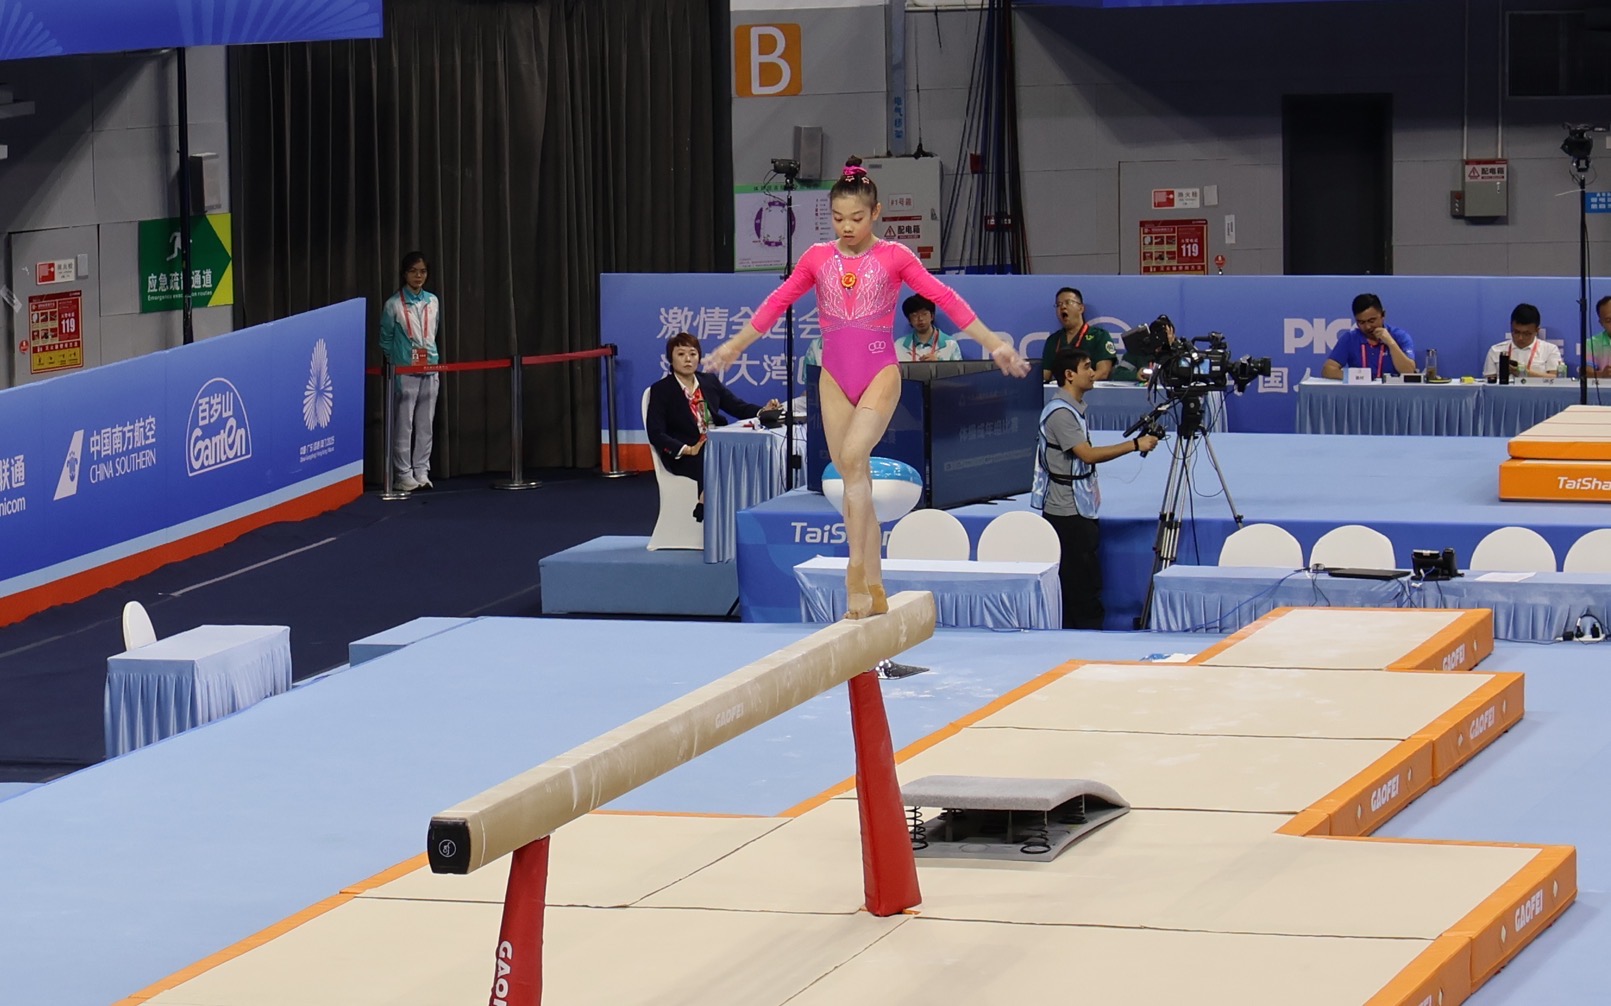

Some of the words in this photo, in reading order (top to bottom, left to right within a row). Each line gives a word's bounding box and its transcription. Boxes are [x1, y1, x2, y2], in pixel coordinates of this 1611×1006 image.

[749, 25, 793, 96] B
[1480, 166, 1505, 175] 配电箱
[897, 224, 921, 235] 配电箱
[1180, 243, 1200, 257] 119
[147, 268, 214, 293] 应急疏通道
[60, 317, 77, 335] 119
[1283, 318, 1358, 354] PIC
[198, 391, 234, 427] 百岁山
[89, 414, 157, 461] 中国南方航空
[89, 460, 115, 484] CHINA
[115, 448, 157, 478] SOUTHERN
[1442, 643, 1466, 671] GAOFEI
[715, 702, 745, 729] GAOFEI
[1469, 705, 1496, 740] GAOFEI
[1370, 773, 1400, 812] GAOFEI
[1514, 888, 1544, 932] GAOFEI
